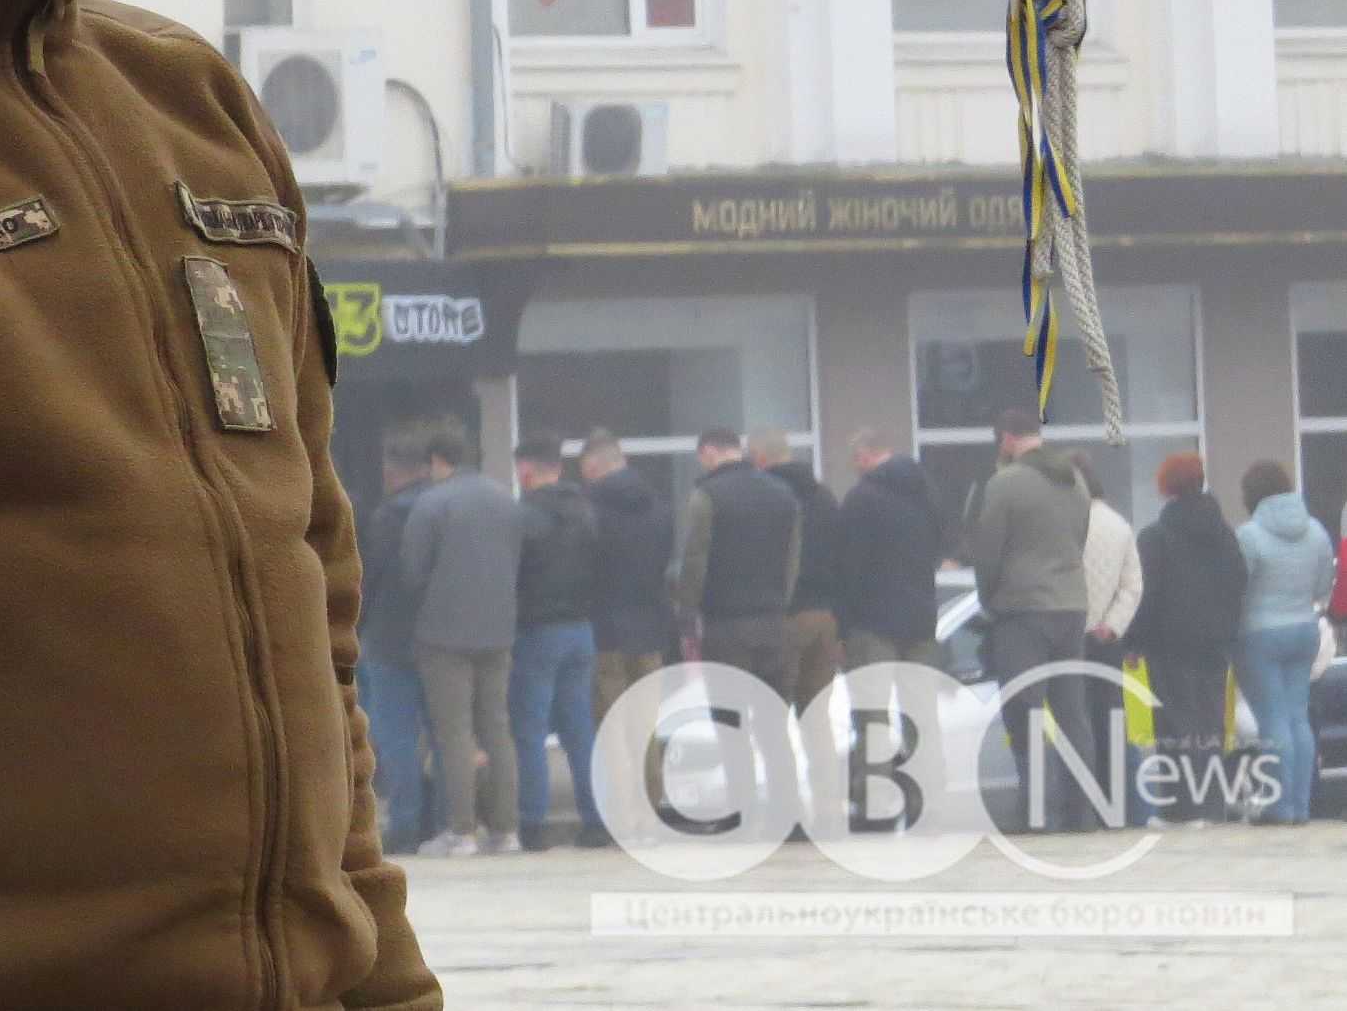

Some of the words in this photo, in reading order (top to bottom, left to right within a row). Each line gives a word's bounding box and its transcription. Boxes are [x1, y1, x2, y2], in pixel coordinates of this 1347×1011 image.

[692, 189, 817, 238] МОДНИЙ
[829, 189, 957, 231] ЖІНОЧИЙ
[969, 194, 1025, 235] ОДЯ
